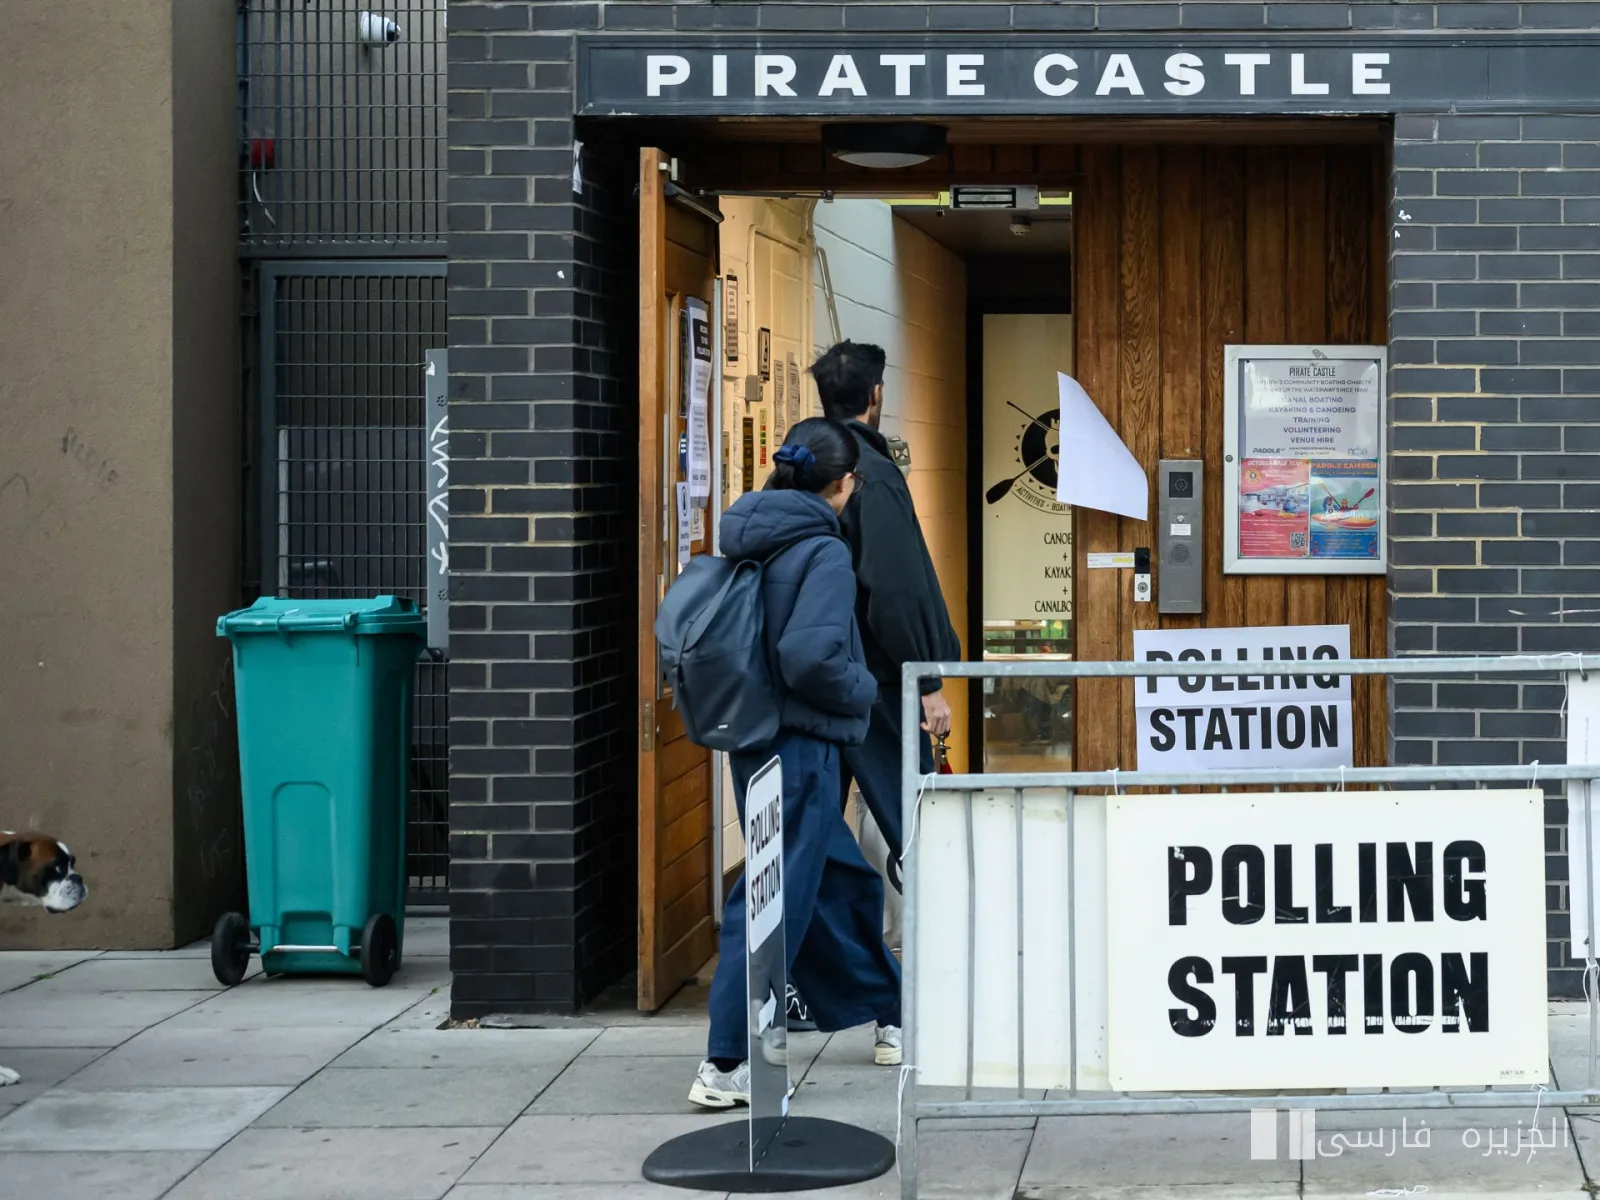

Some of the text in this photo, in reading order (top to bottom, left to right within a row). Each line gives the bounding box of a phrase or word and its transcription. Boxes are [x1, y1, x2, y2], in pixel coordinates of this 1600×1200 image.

[646, 53, 1391, 97] PIRATE CASTLE
[1289, 367, 1336, 377] PIRATE CASTLE
[1016, 486, 1046, 508] ACTIVITIES
[1044, 566, 1073, 579] KAYAK
[1146, 644, 1340, 694] POLLING
[1150, 704, 1339, 752] STATION
[751, 793, 780, 861] POLLING
[751, 853, 781, 921] STATION
[1168, 839, 1488, 926] POLLING
[1167, 951, 1490, 1037] STATION
